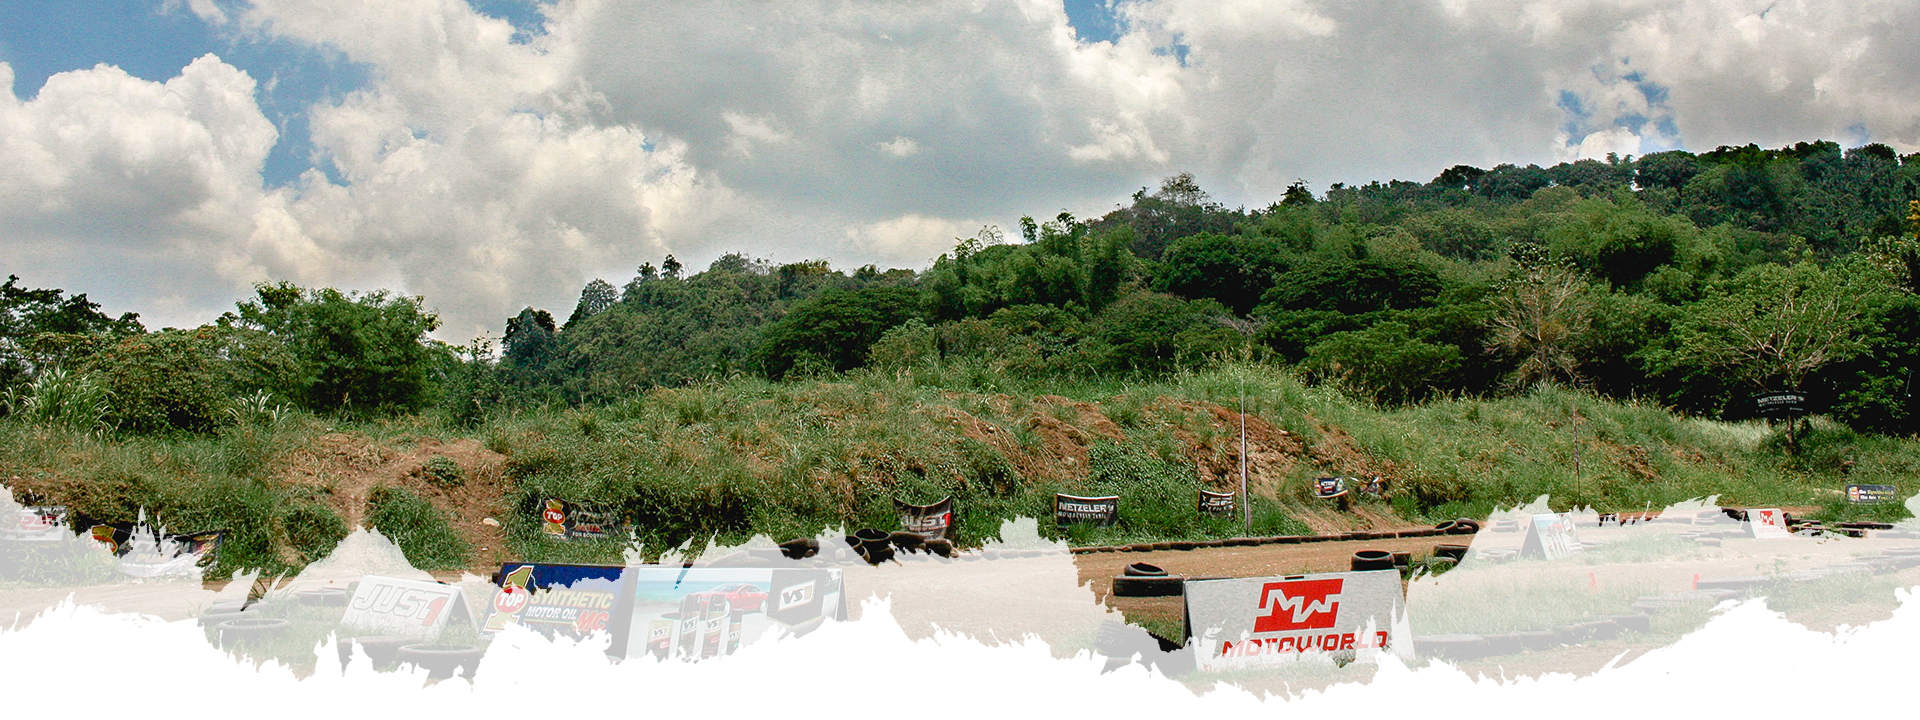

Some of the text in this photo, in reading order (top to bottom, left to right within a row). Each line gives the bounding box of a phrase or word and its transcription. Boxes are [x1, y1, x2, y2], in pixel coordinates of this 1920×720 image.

[1058, 502, 1107, 512] METZELER
[546, 510, 563, 520] TOP
[498, 593, 525, 608] TOP
[530, 588, 614, 610] SYNTHETIC
[525, 605, 578, 620] MOTOR OIL
[573, 610, 609, 633] MC
[1221, 630, 1388, 658] MOTOWORLD
